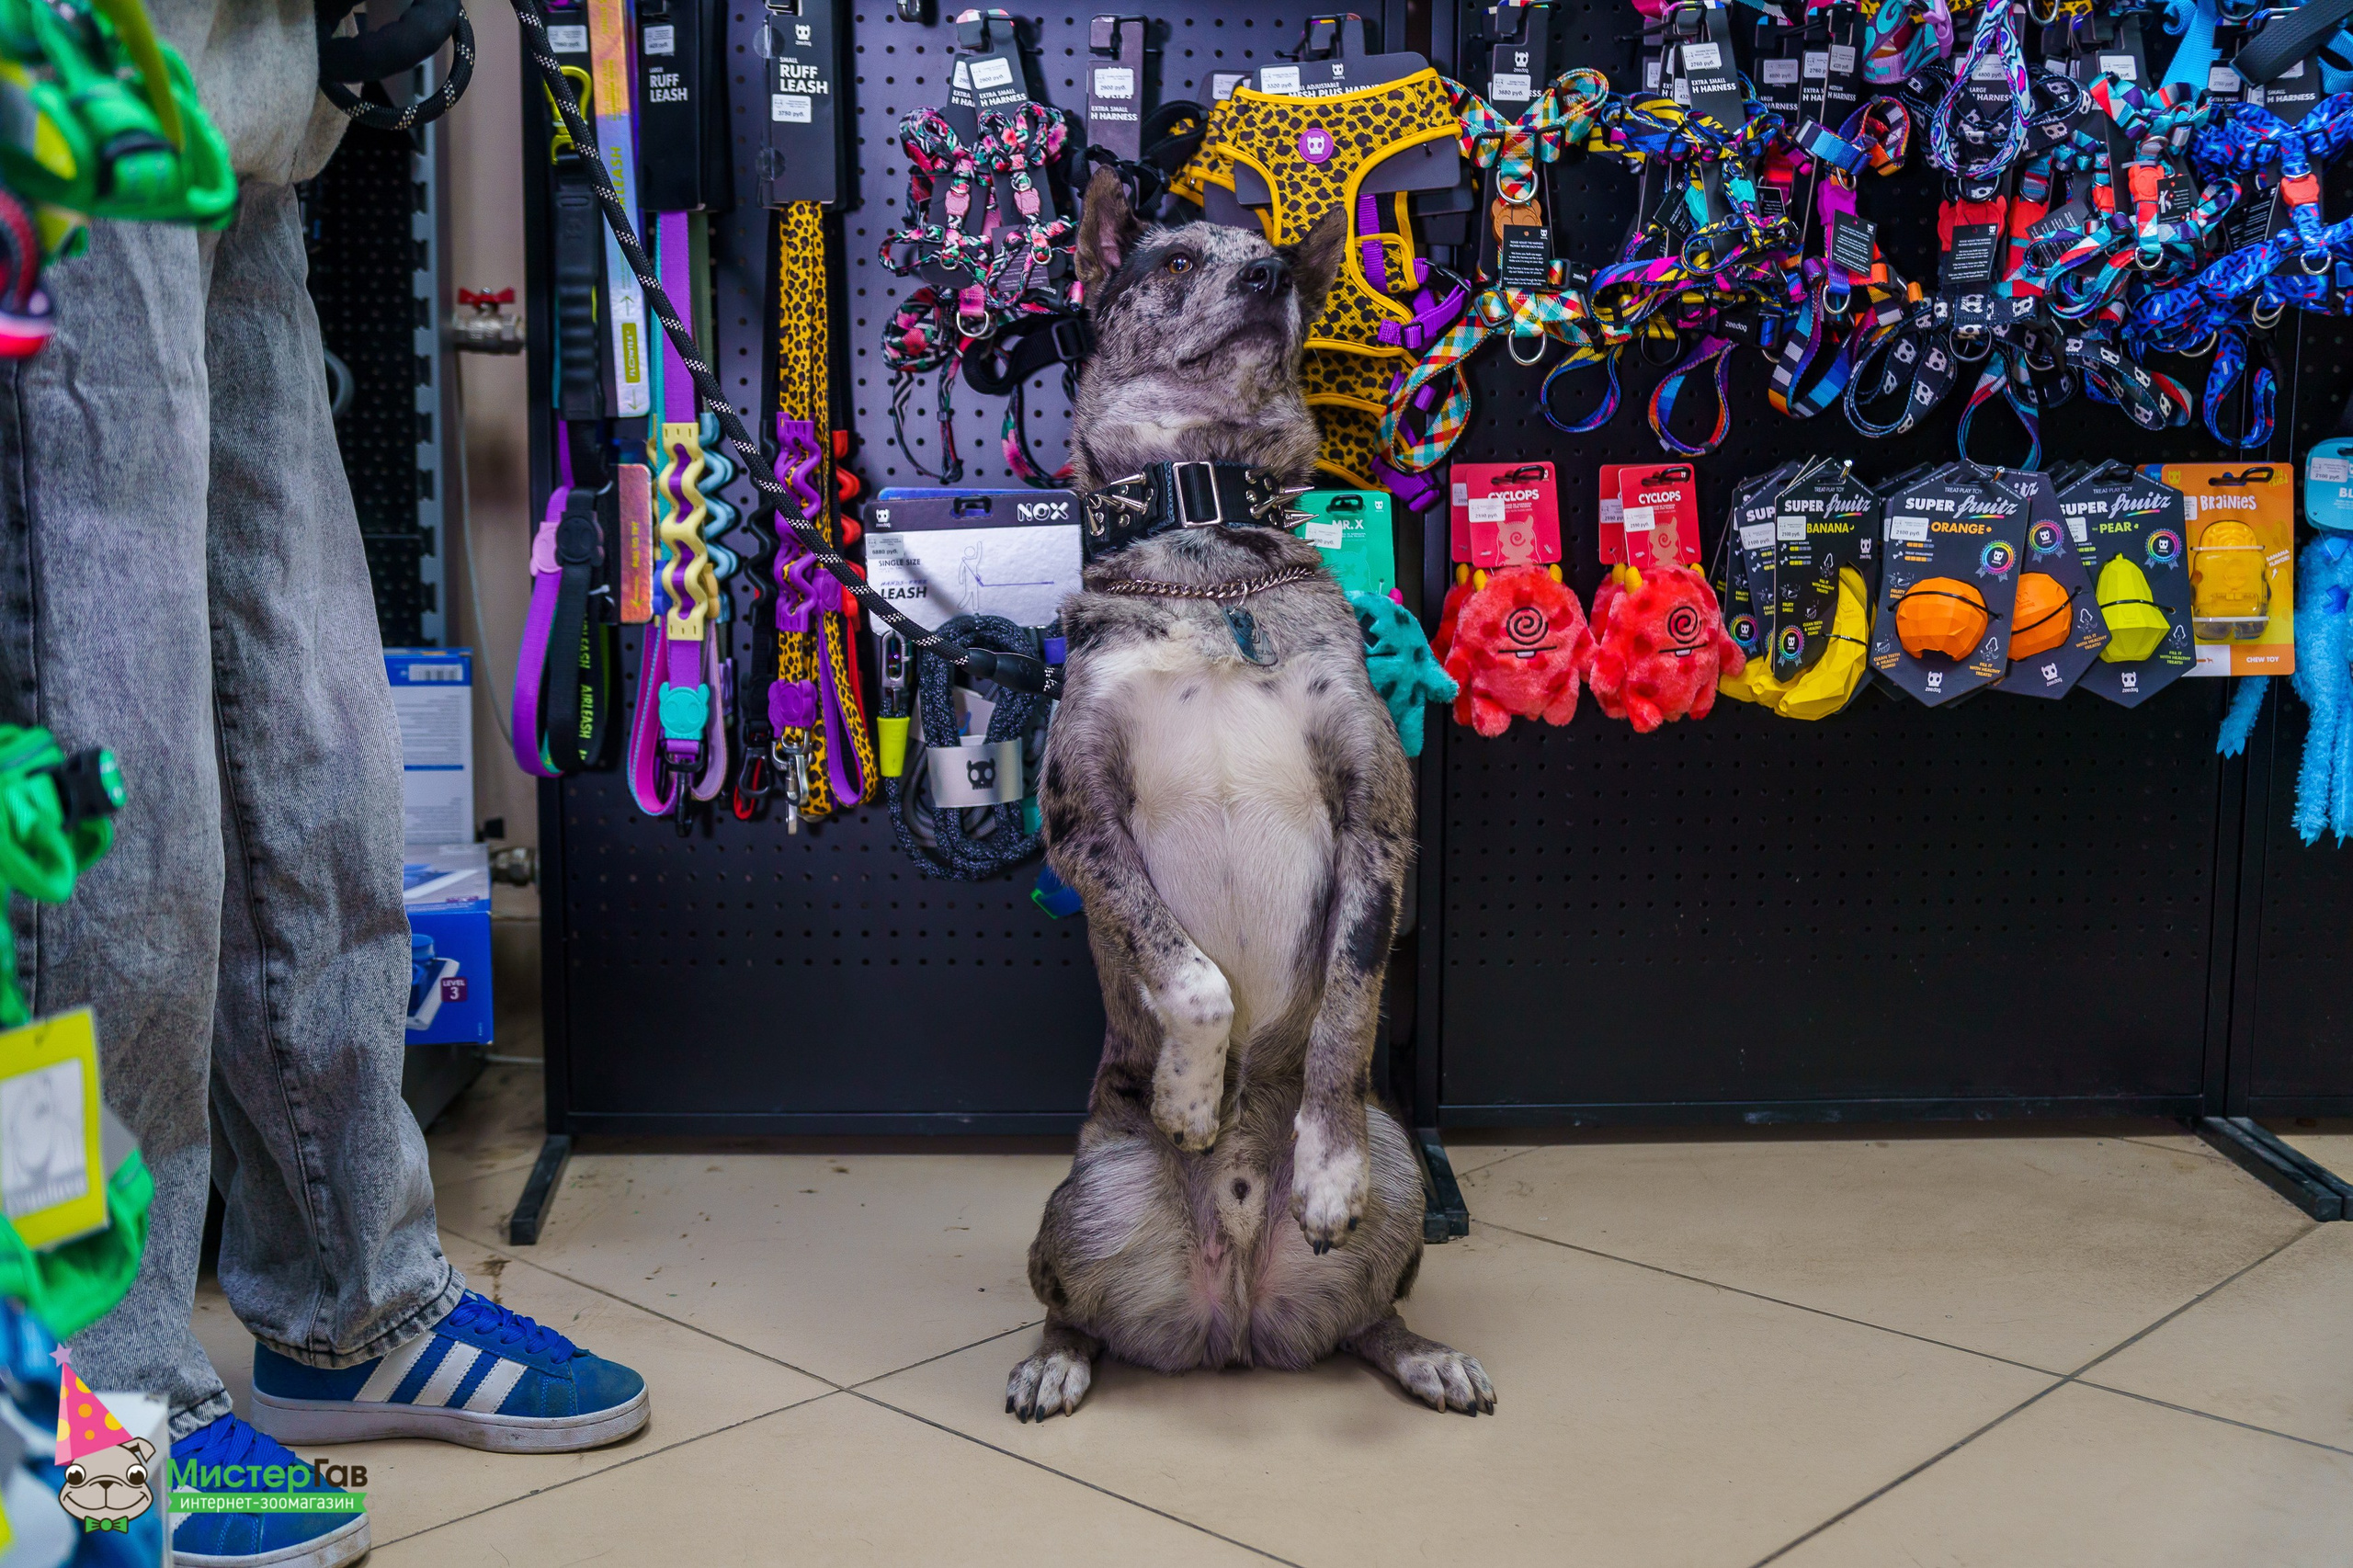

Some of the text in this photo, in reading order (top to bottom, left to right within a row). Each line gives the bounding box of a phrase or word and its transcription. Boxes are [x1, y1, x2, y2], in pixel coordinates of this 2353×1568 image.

[779, 56, 798, 64] SMALL
[779, 63, 818, 79] RUFF
[649, 73, 680, 89] RUFF
[779, 78, 829, 95] LEASH
[1306, 81, 1341, 91] ADJUSTABLE
[650, 87, 688, 103] LEASH
[979, 87, 1017, 100] EXTRA SMALL
[1691, 83, 1737, 95] H HARNESS
[981, 98, 991, 108] H
[990, 92, 1029, 107] HARNESS
[1802, 94, 1810, 102] H
[1832, 91, 1857, 102] HARNESS
[2267, 92, 2317, 104] H HARNESS
[1090, 111, 1138, 122] H HARNESS
[1487, 489, 1540, 502] CYCLOPS
[1638, 490, 1682, 505] CYCLOPS
[1017, 501, 1071, 523] NOX
[1784, 493, 1873, 519] SUPER fruitz
[1904, 494, 2020, 520] SUPER fruitz
[2059, 492, 2172, 519] SUPER fruitz
[1806, 522, 1850, 534] BANANA
[1930, 521, 1986, 535] ORANGE
[2099, 520, 2132, 534] PEAR
[2266, 549, 2290, 562] BANANA
[878, 558, 921, 567] SINGLE SIZE
[880, 585, 928, 600] LEASH
[2245, 655, 2280, 664] CHEW TOY
[1925, 686, 1941, 694] zeedog
[579, 684, 595, 739] AIRLEASH
[442, 979, 466, 987] LEVEL
[449, 986, 460, 1001] 3
